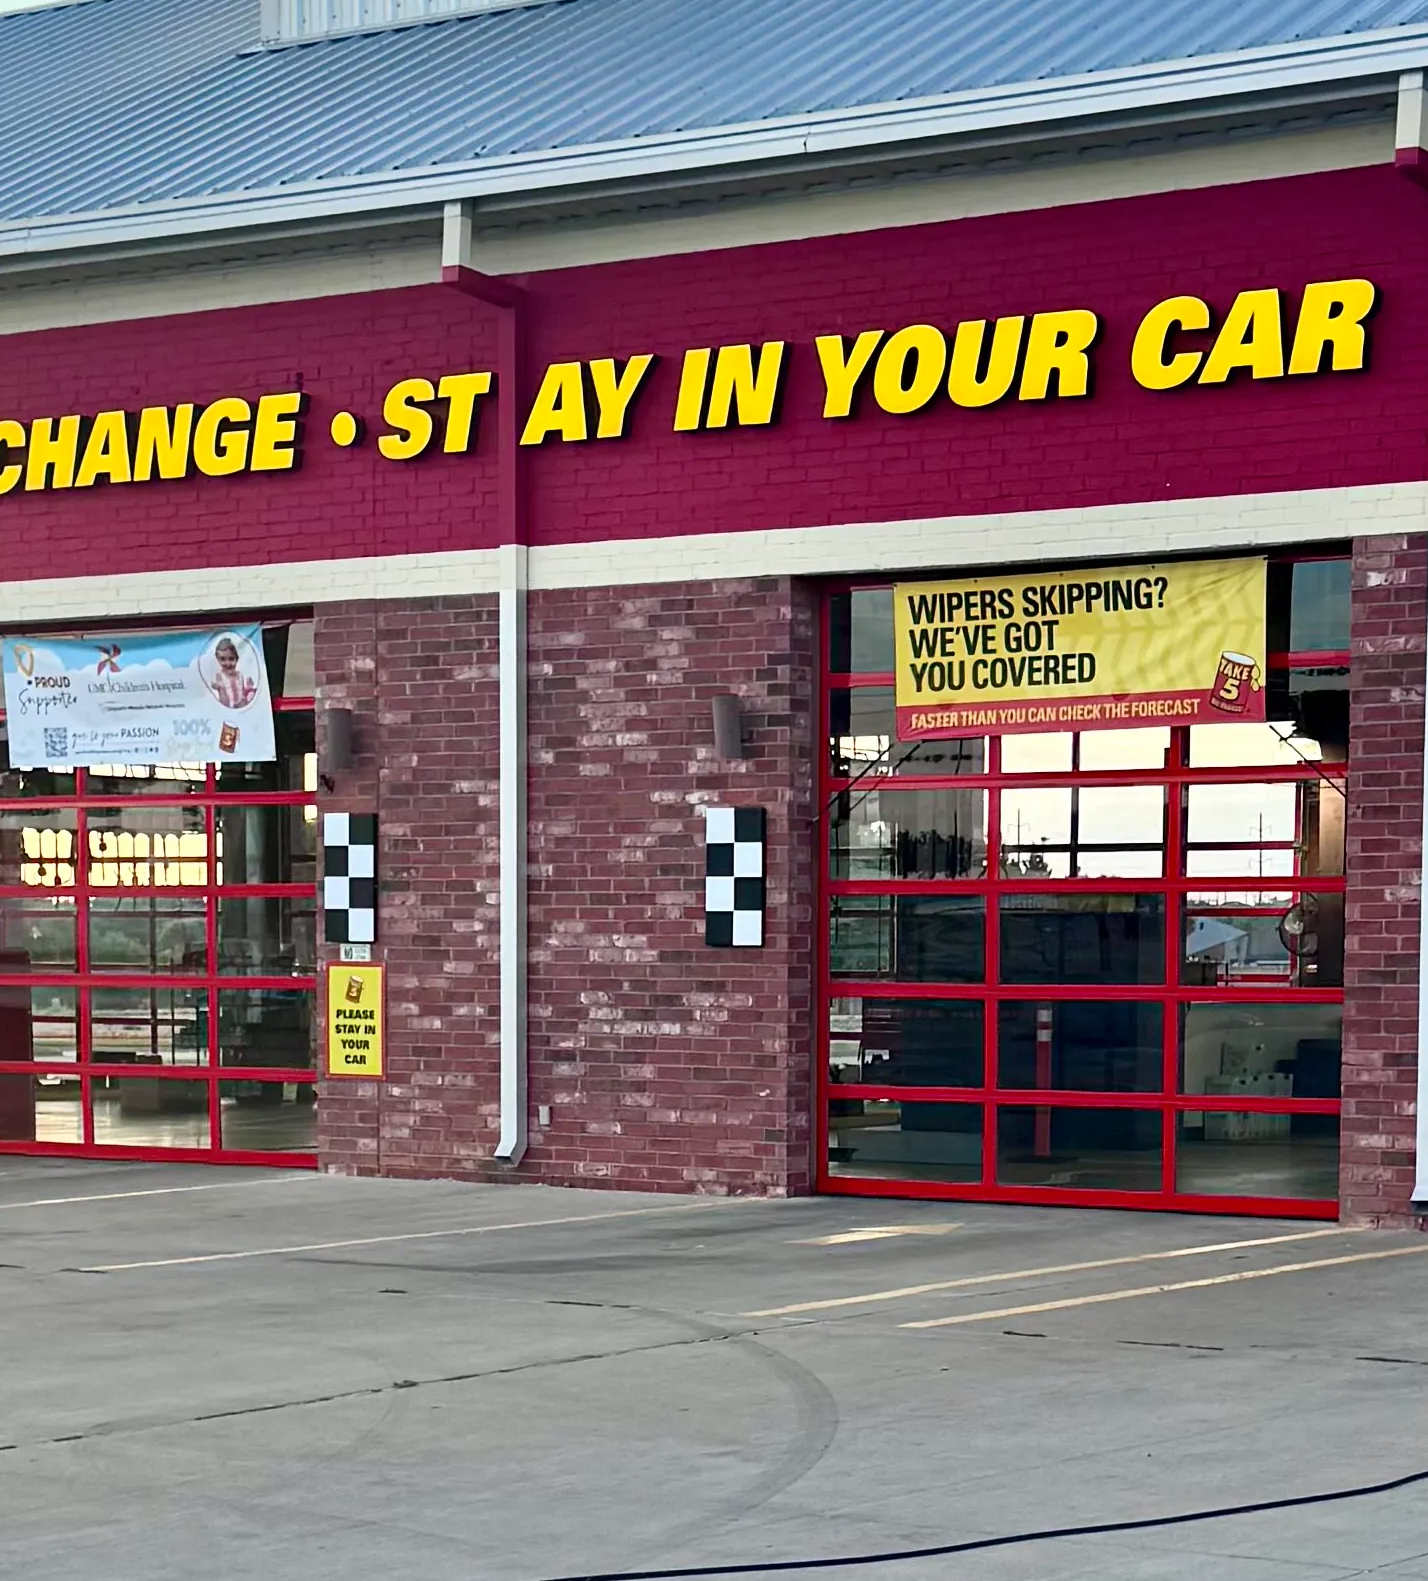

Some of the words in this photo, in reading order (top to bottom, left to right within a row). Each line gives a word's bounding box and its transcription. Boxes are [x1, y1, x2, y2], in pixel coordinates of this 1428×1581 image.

[673, 339, 785, 433] IN
[813, 307, 1098, 419] YOUR
[1130, 277, 1375, 391] CAR
[907, 587, 1015, 625] WIPERS
[1022, 576, 1169, 617] SKIPPING?
[908, 624, 997, 659] WE'VE
[1004, 619, 1060, 653] GOT
[909, 660, 965, 693] YOU
[971, 652, 1096, 689] COVERED
[1219, 658, 1251, 680] TAKE
[34, 676, 71, 689] PROUD
[1219, 677, 1241, 701] 5
[911, 711, 959, 729] FASTER
[961, 709, 997, 727] THAN
[1000, 708, 1027, 725] YOU
[1028, 706, 1058, 723] CAN
[1059, 704, 1102, 722] CHECK
[1105, 701, 1130, 719] THE
[1131, 698, 1201, 718] FORECAST
[121, 726, 160, 738] PASSION
[335, 1008, 375, 1020] PLEASE
[334, 1024, 361, 1035] STAY
[364, 1024, 376, 1036] IN
[340, 1038, 370, 1050] YOUR
[344, 1054, 367, 1065] CAR
